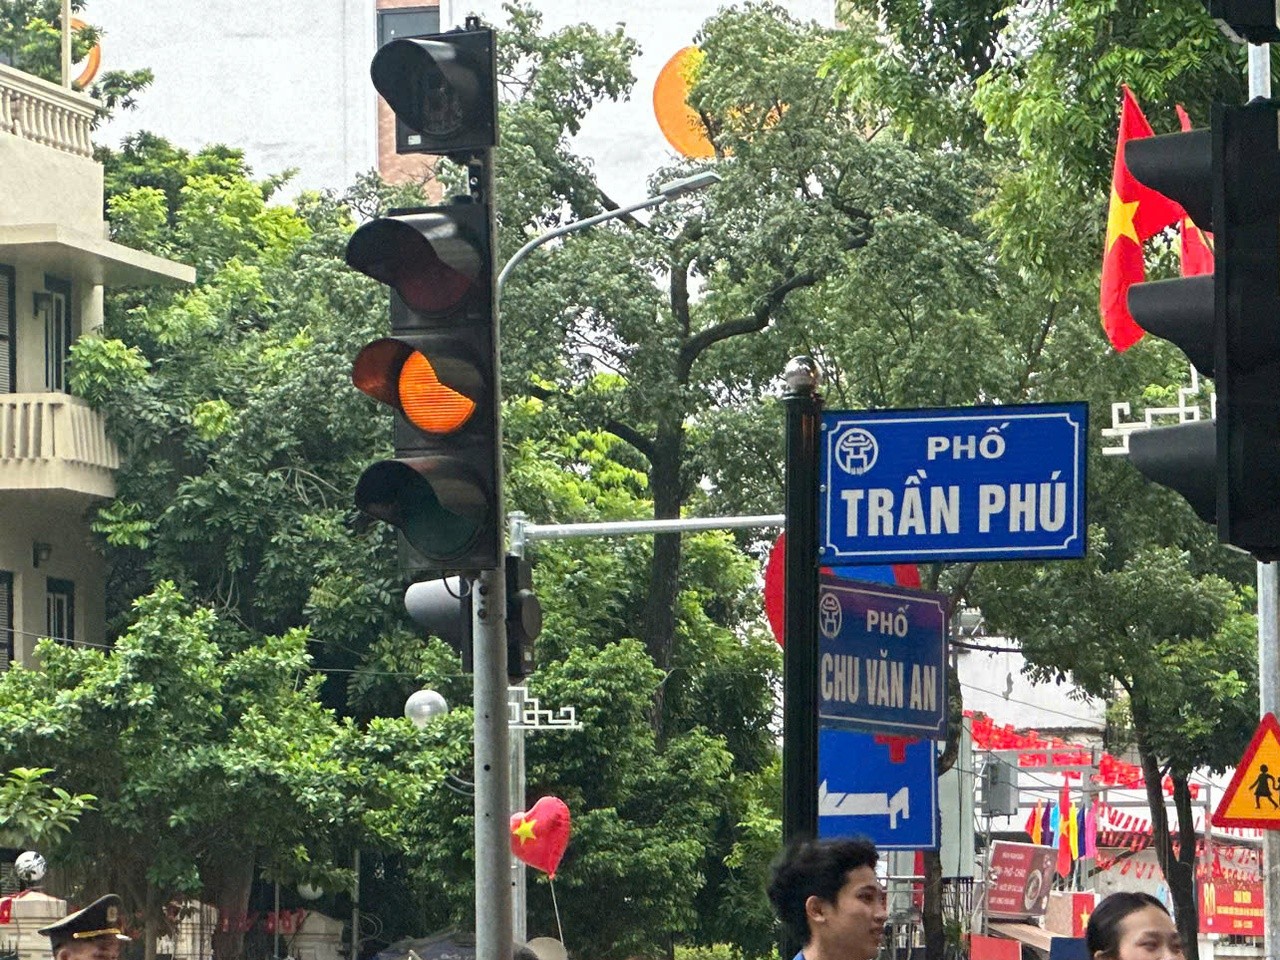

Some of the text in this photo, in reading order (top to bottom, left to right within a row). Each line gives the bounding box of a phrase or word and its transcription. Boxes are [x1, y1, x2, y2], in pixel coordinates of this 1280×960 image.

[927, 422, 1010, 461] PHỐ
[841, 469, 1067, 537] TRẦN PHÚ
[866, 604, 911, 638] PHỐ
[821, 649, 937, 712] CHU VĂN AN
